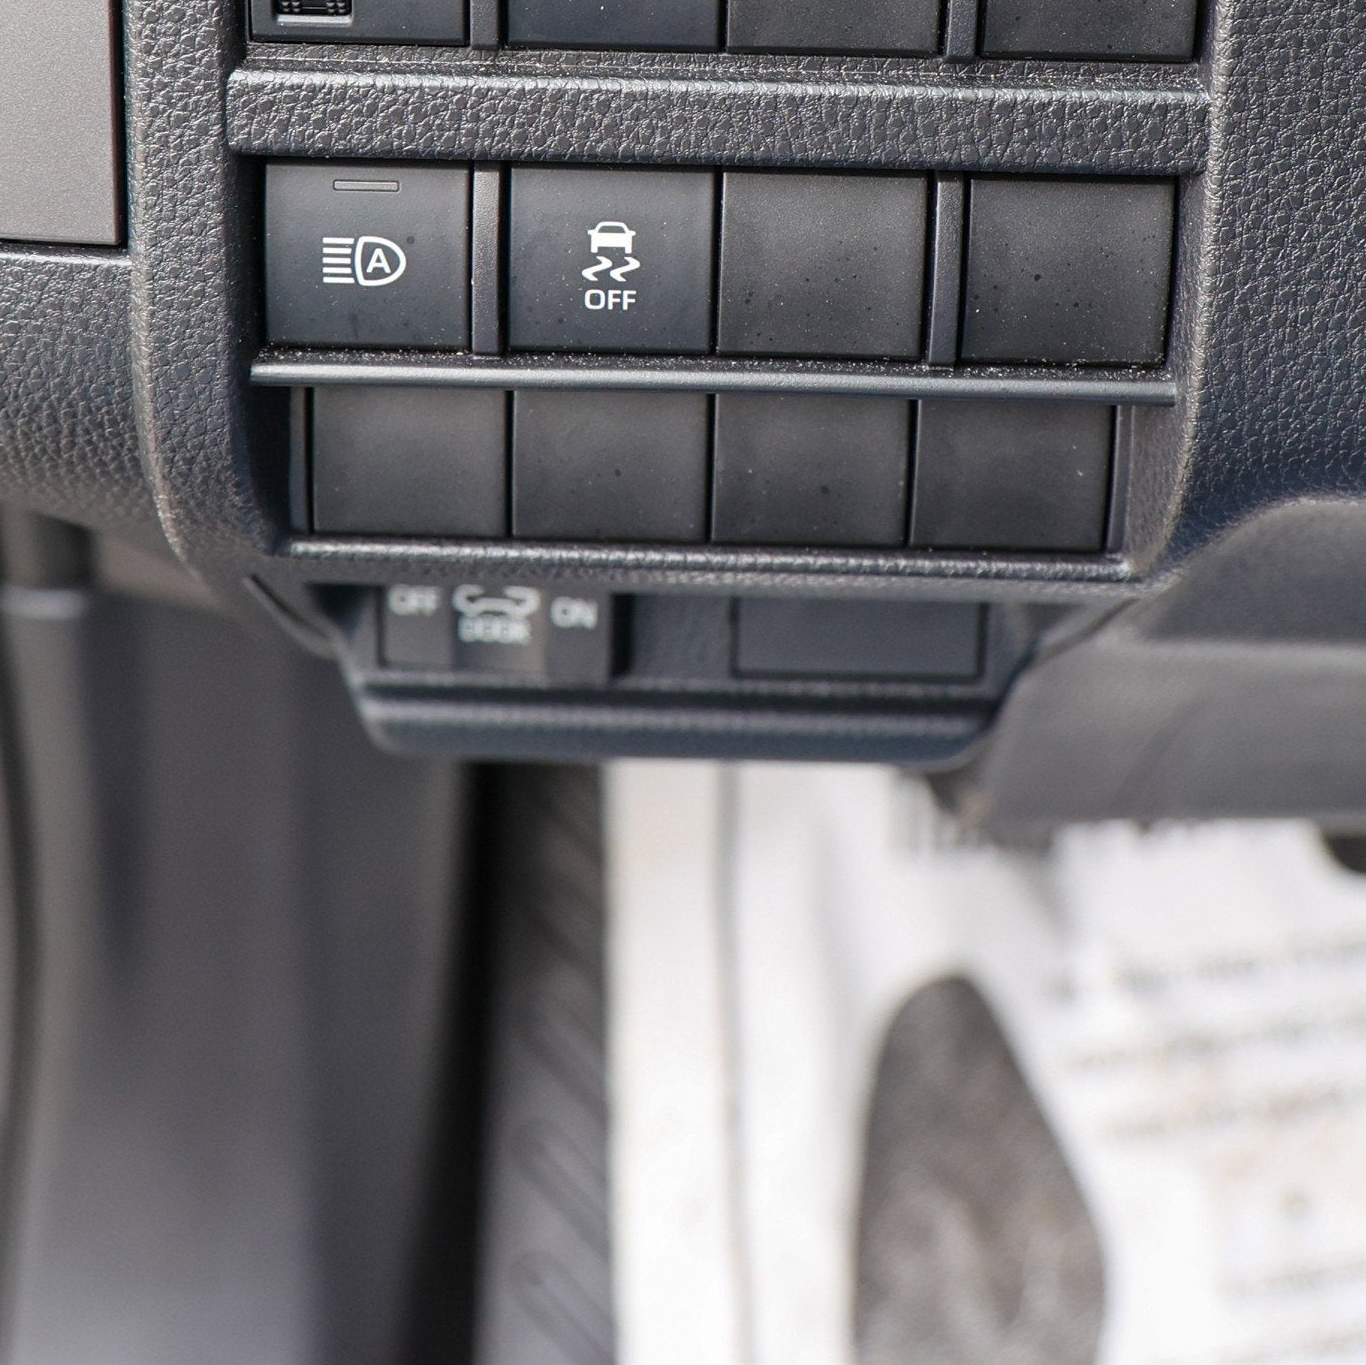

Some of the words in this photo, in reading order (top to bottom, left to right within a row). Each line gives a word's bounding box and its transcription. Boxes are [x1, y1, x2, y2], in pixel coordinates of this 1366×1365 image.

[366, 248, 392, 273] A
[584, 290, 636, 310] OFF
[388, 585, 440, 617] OFF
[550, 596, 598, 629] ON
